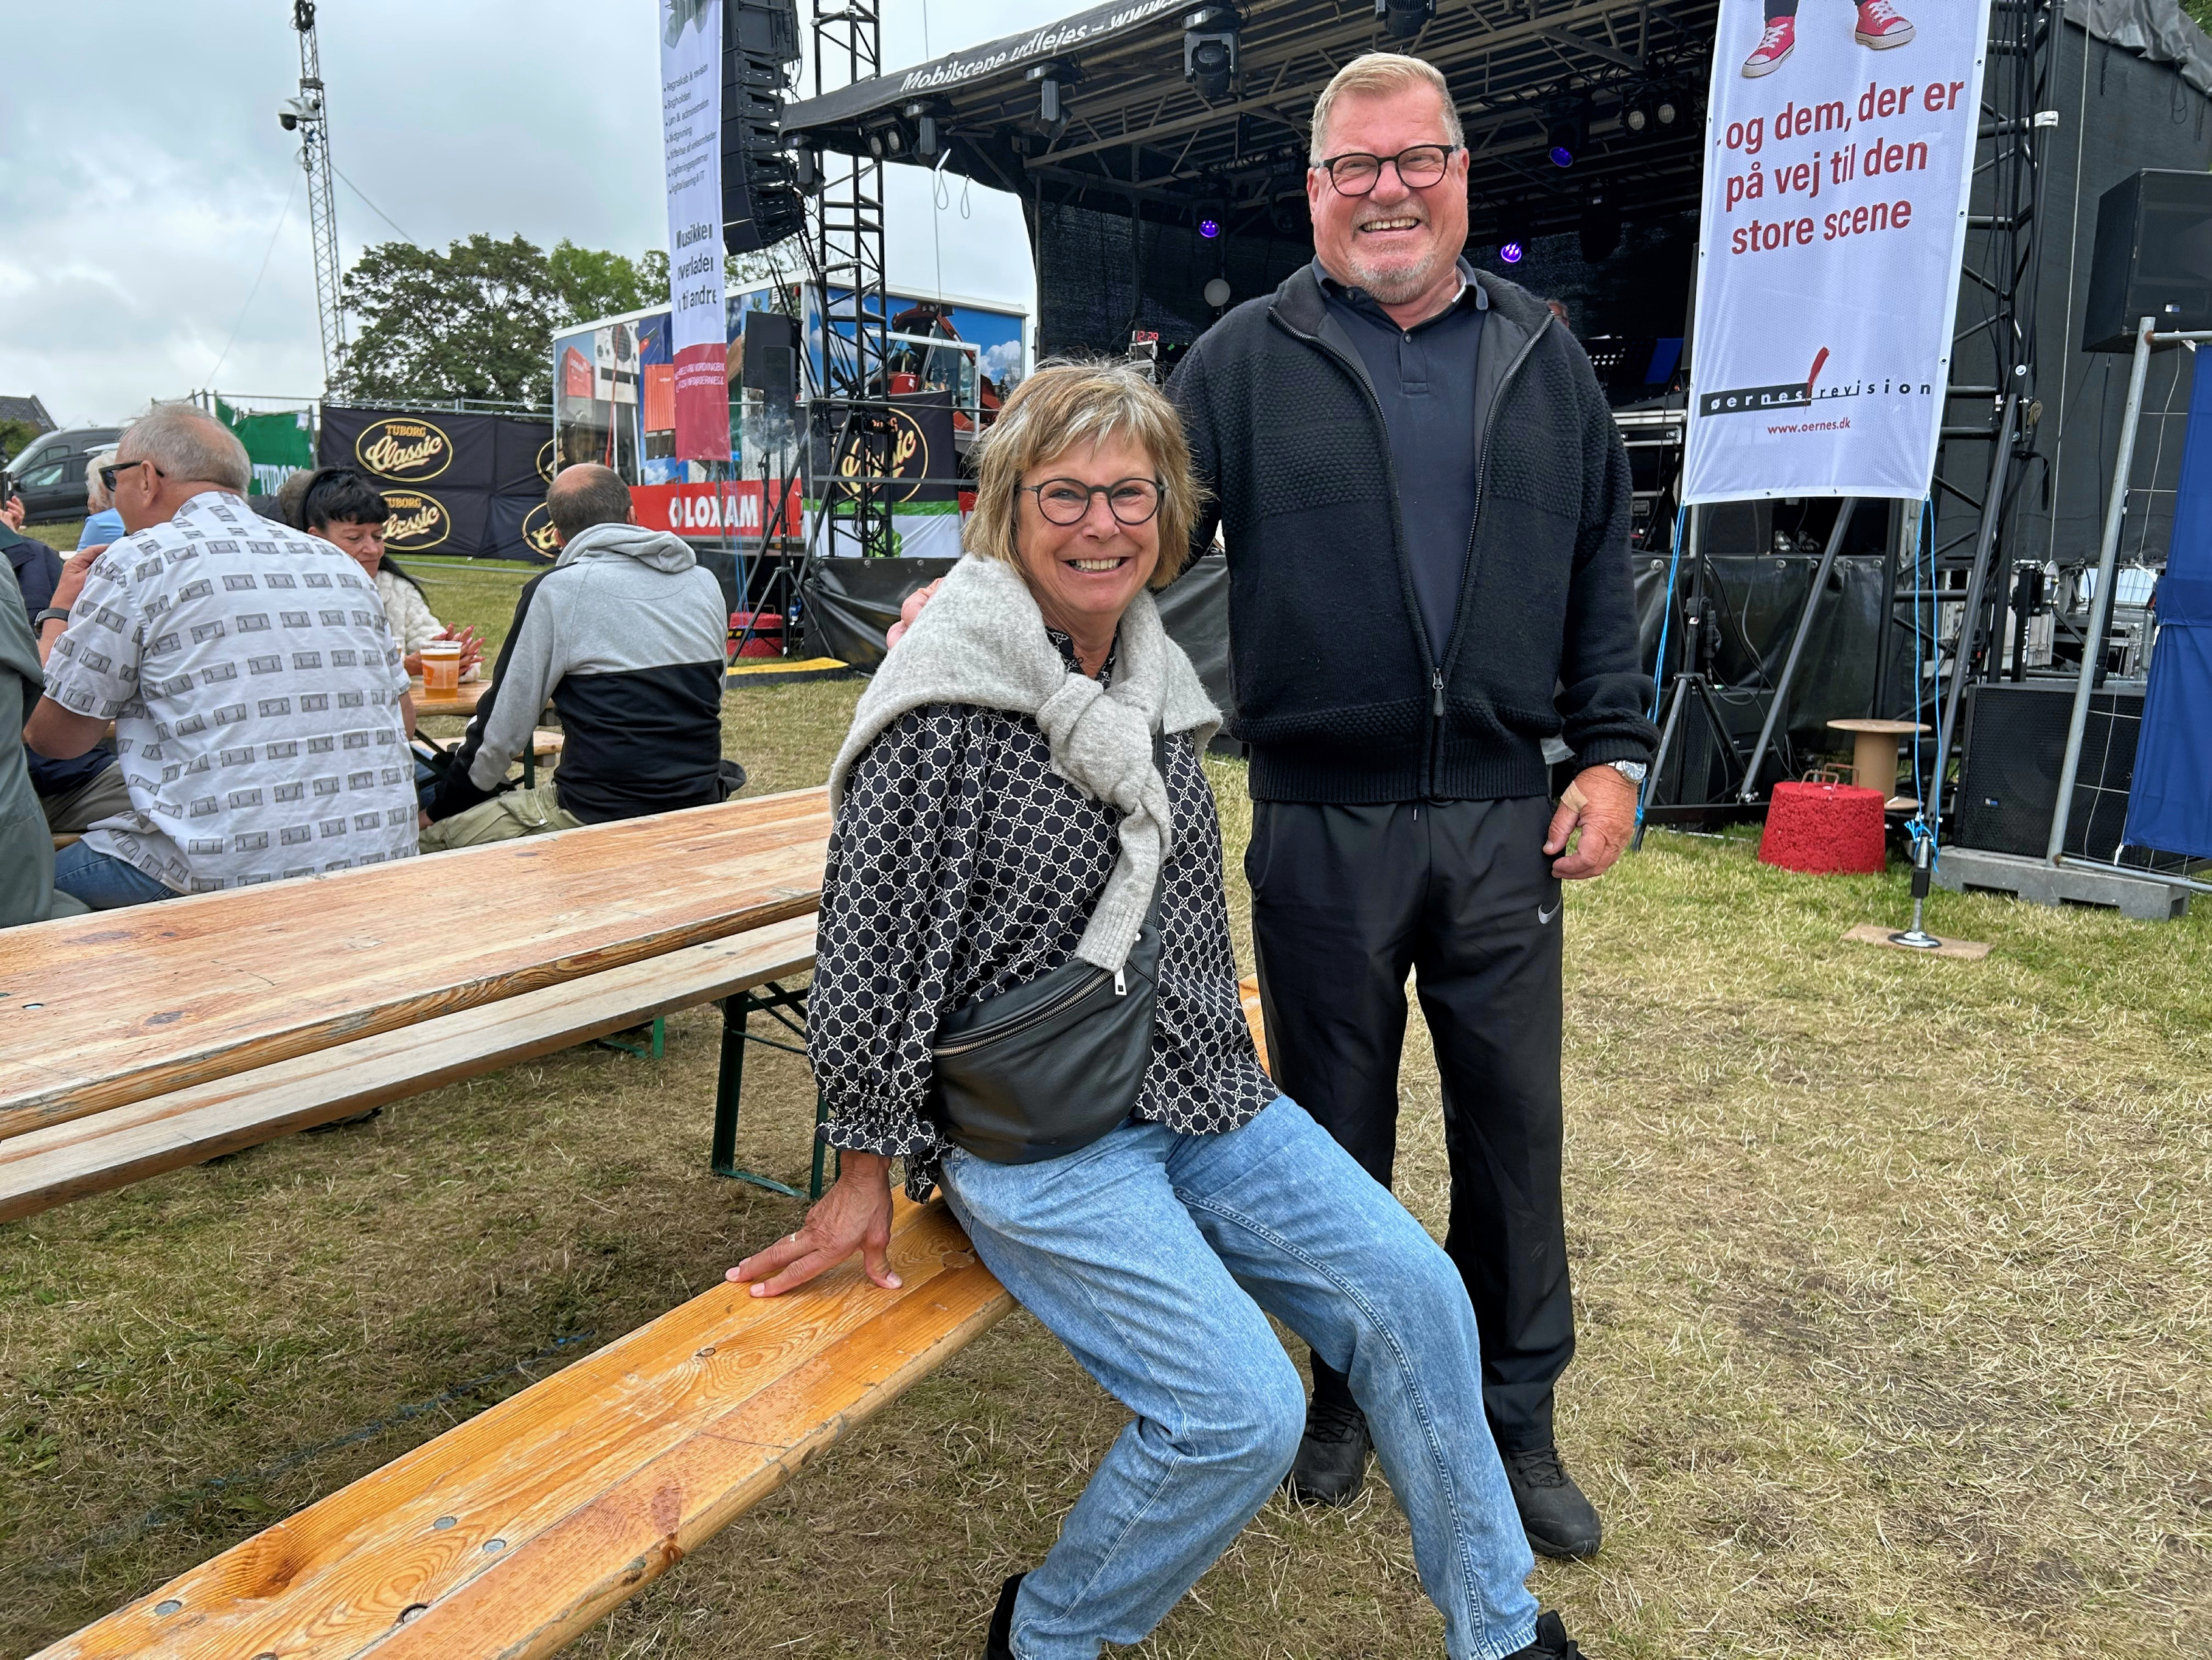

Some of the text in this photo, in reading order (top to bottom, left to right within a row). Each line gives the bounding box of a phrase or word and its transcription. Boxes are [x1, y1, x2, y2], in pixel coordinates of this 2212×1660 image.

[900, 52, 1006, 92] Mobilscene
[1009, 24, 1087, 55] udlejes
[1108, 0, 1181, 30] www.
[1726, 81, 1964, 155] og dem, der er
[1726, 137, 1927, 212] på vej til den
[1731, 200, 1912, 254] store scene
[385, 425, 426, 437] TUBORG
[1767, 417, 1851, 434] www.oernes.dk
[365, 434, 442, 471] Classic
[685, 495, 758, 528] LOXAM
